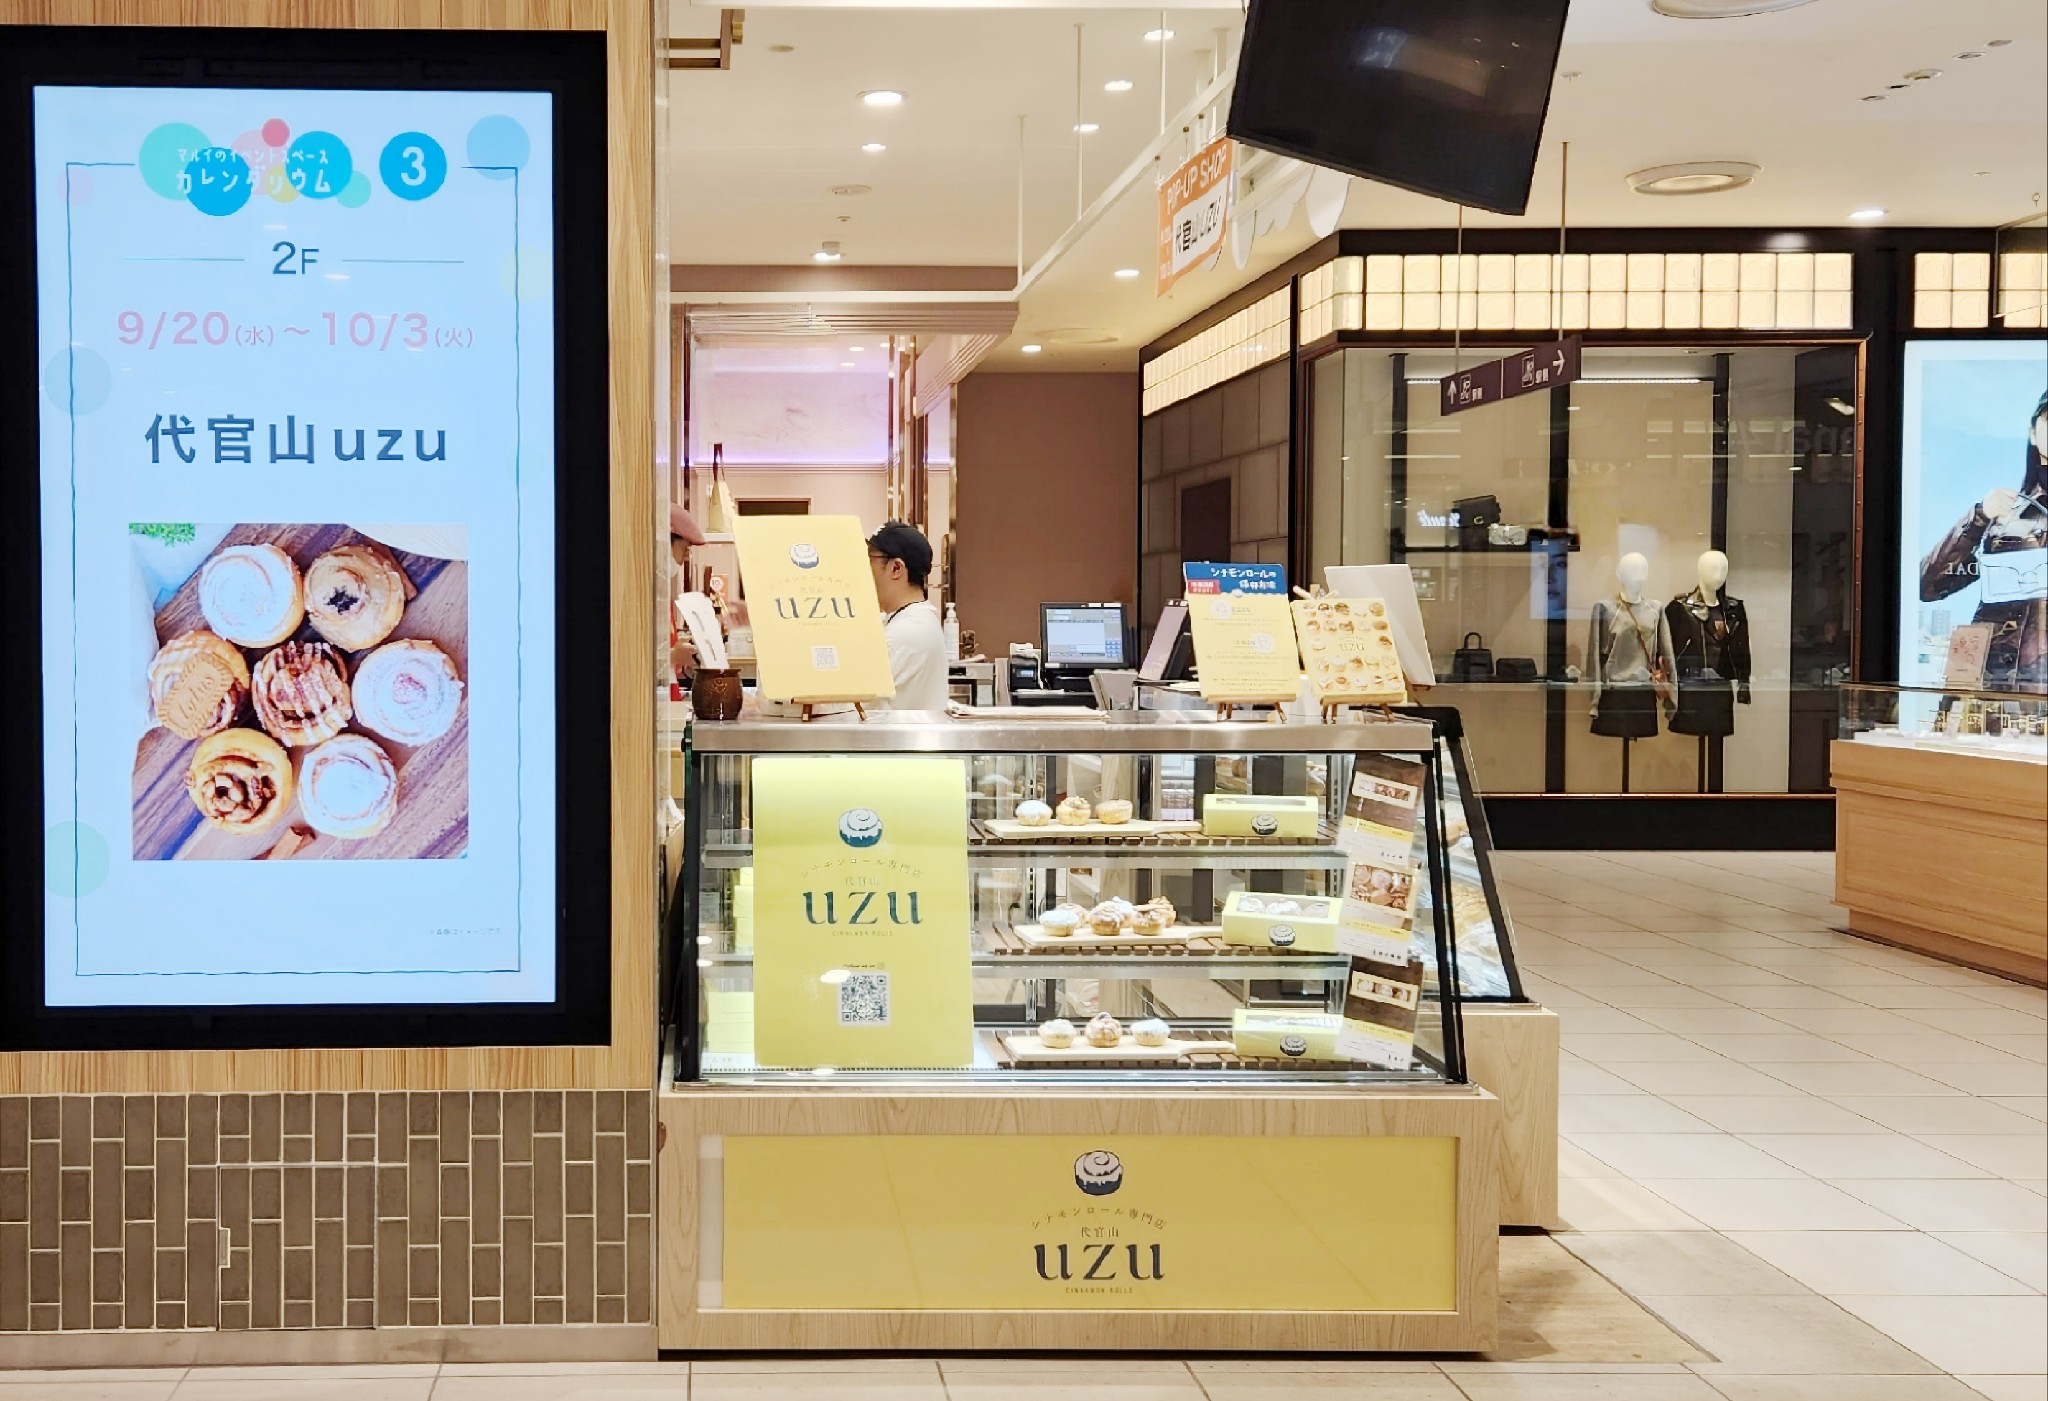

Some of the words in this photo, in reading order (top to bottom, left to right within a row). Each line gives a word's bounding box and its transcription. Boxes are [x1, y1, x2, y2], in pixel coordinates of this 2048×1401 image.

[176, 165, 332, 195] カレンダリウム
[400, 145, 427, 187] 3
[1200, 143, 1228, 188] SHOP
[271, 240, 320, 276] 2F
[773, 596, 856, 619] uzu
[802, 891, 924, 925] uzu
[1031, 1207, 1168, 1230] シナモンロール専門店
[1033, 1243, 1165, 1281] uzu
